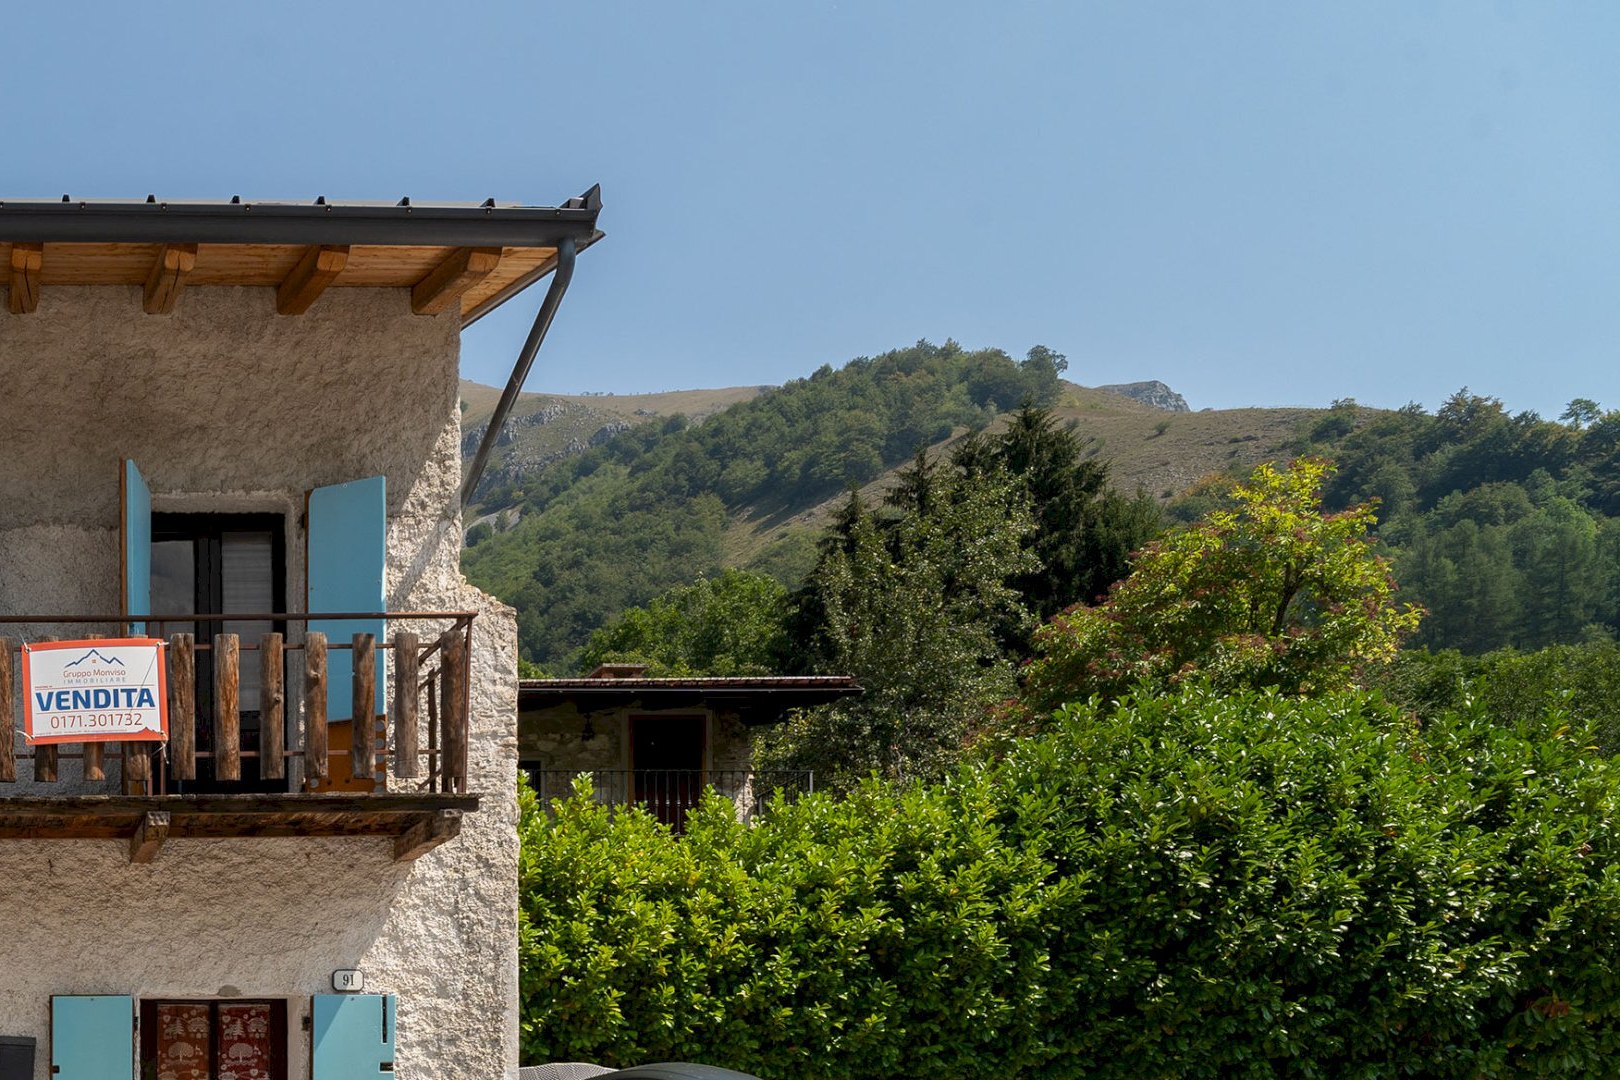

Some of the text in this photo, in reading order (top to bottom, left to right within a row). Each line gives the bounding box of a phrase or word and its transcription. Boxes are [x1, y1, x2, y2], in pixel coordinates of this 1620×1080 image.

[63, 669, 126, 679] Gruppo Monviso
[63, 676, 126, 684] IMMOBILIARE
[35, 687, 156, 712] VENDITA
[50, 712, 143, 729] 0171.301732
[342, 974, 355, 986] 91
